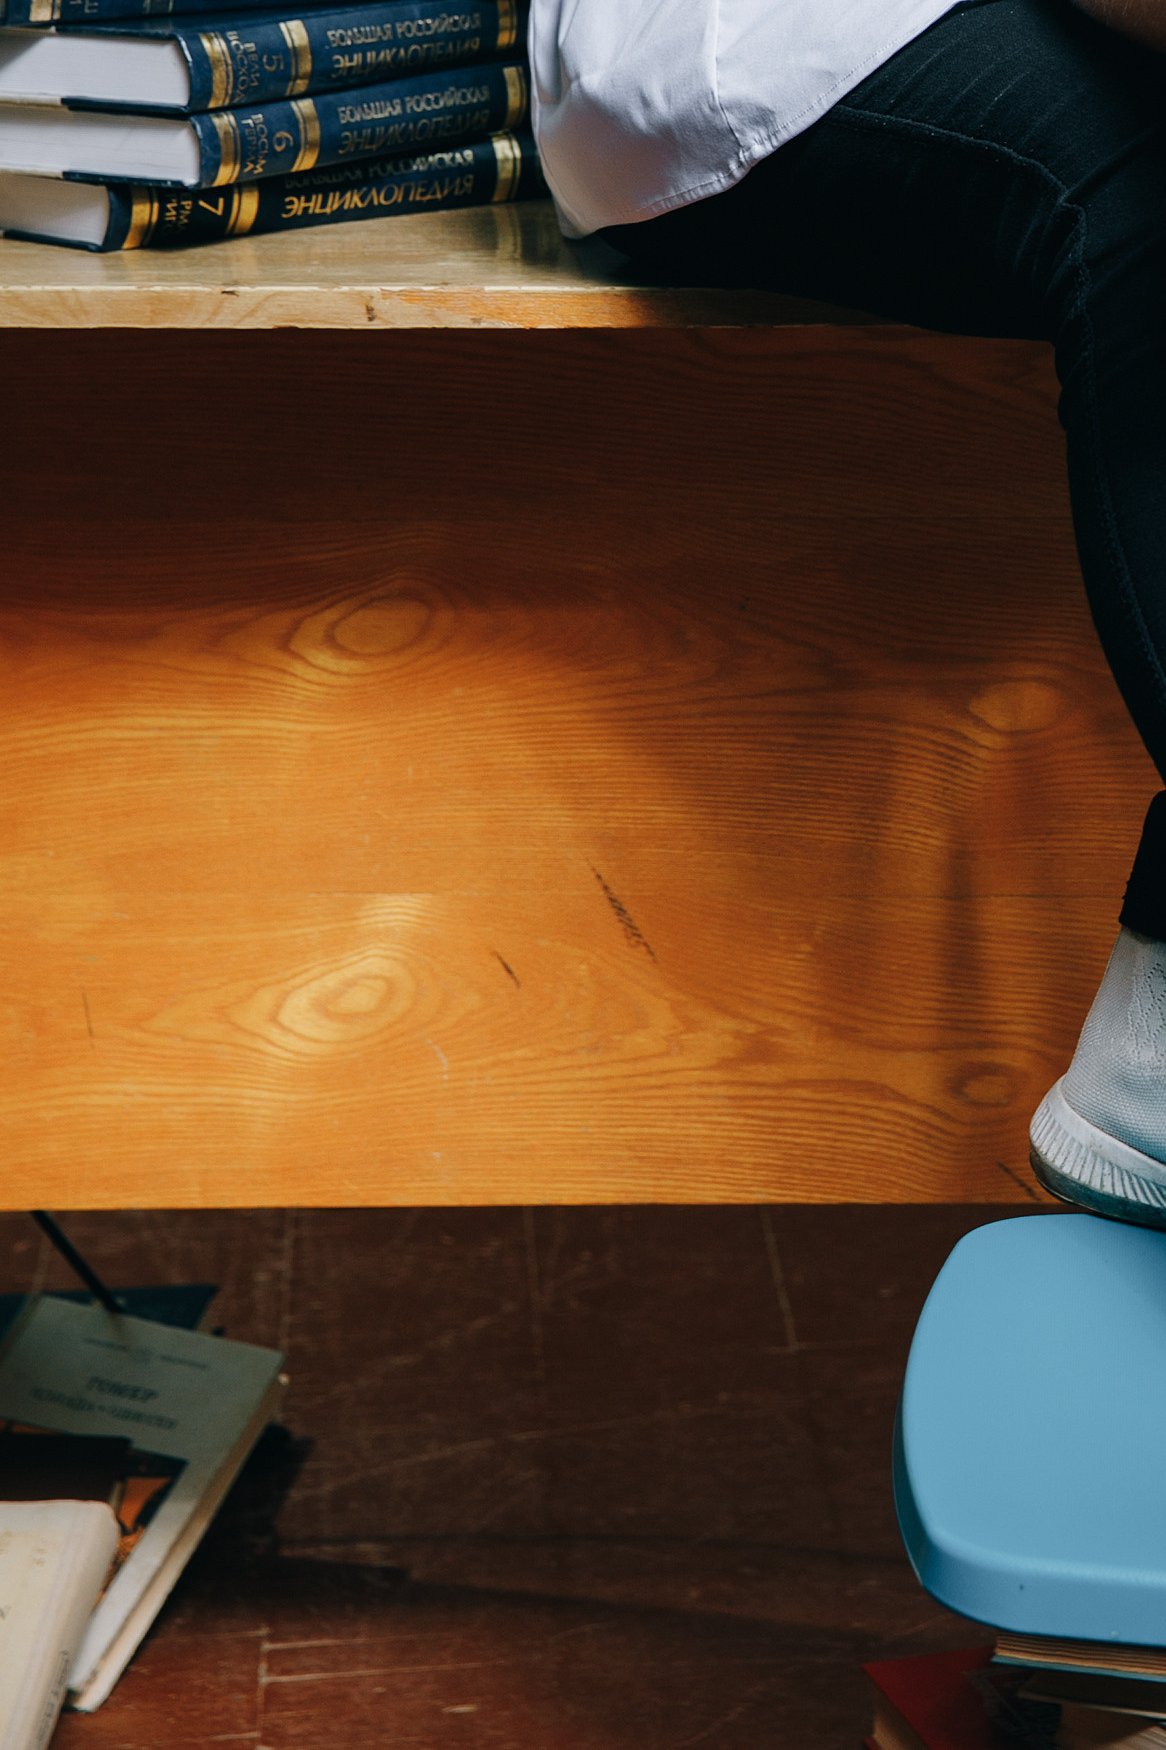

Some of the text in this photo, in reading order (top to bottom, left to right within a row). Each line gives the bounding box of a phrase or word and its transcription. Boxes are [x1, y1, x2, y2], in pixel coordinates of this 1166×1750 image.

[326, 12, 482, 48] БОЛЬШАЯ РОССИЙСКАЯ
[262, 53, 285, 72] 5
[331, 36, 481, 79] ЭНЦИКЛОПЕДИЯ
[336, 84, 492, 125] БОЛЬШАЯ РОССИЙСКАЯ
[272, 130, 295, 153] 6
[338, 109, 491, 155] ЭНЦИКЛОПЕДИЯ
[368, 148, 476, 179] РОССИЙСКАЯ
[198, 197, 225, 216] 7
[281, 173, 476, 219] ЭНЦИКЛОПЕДИЯ
